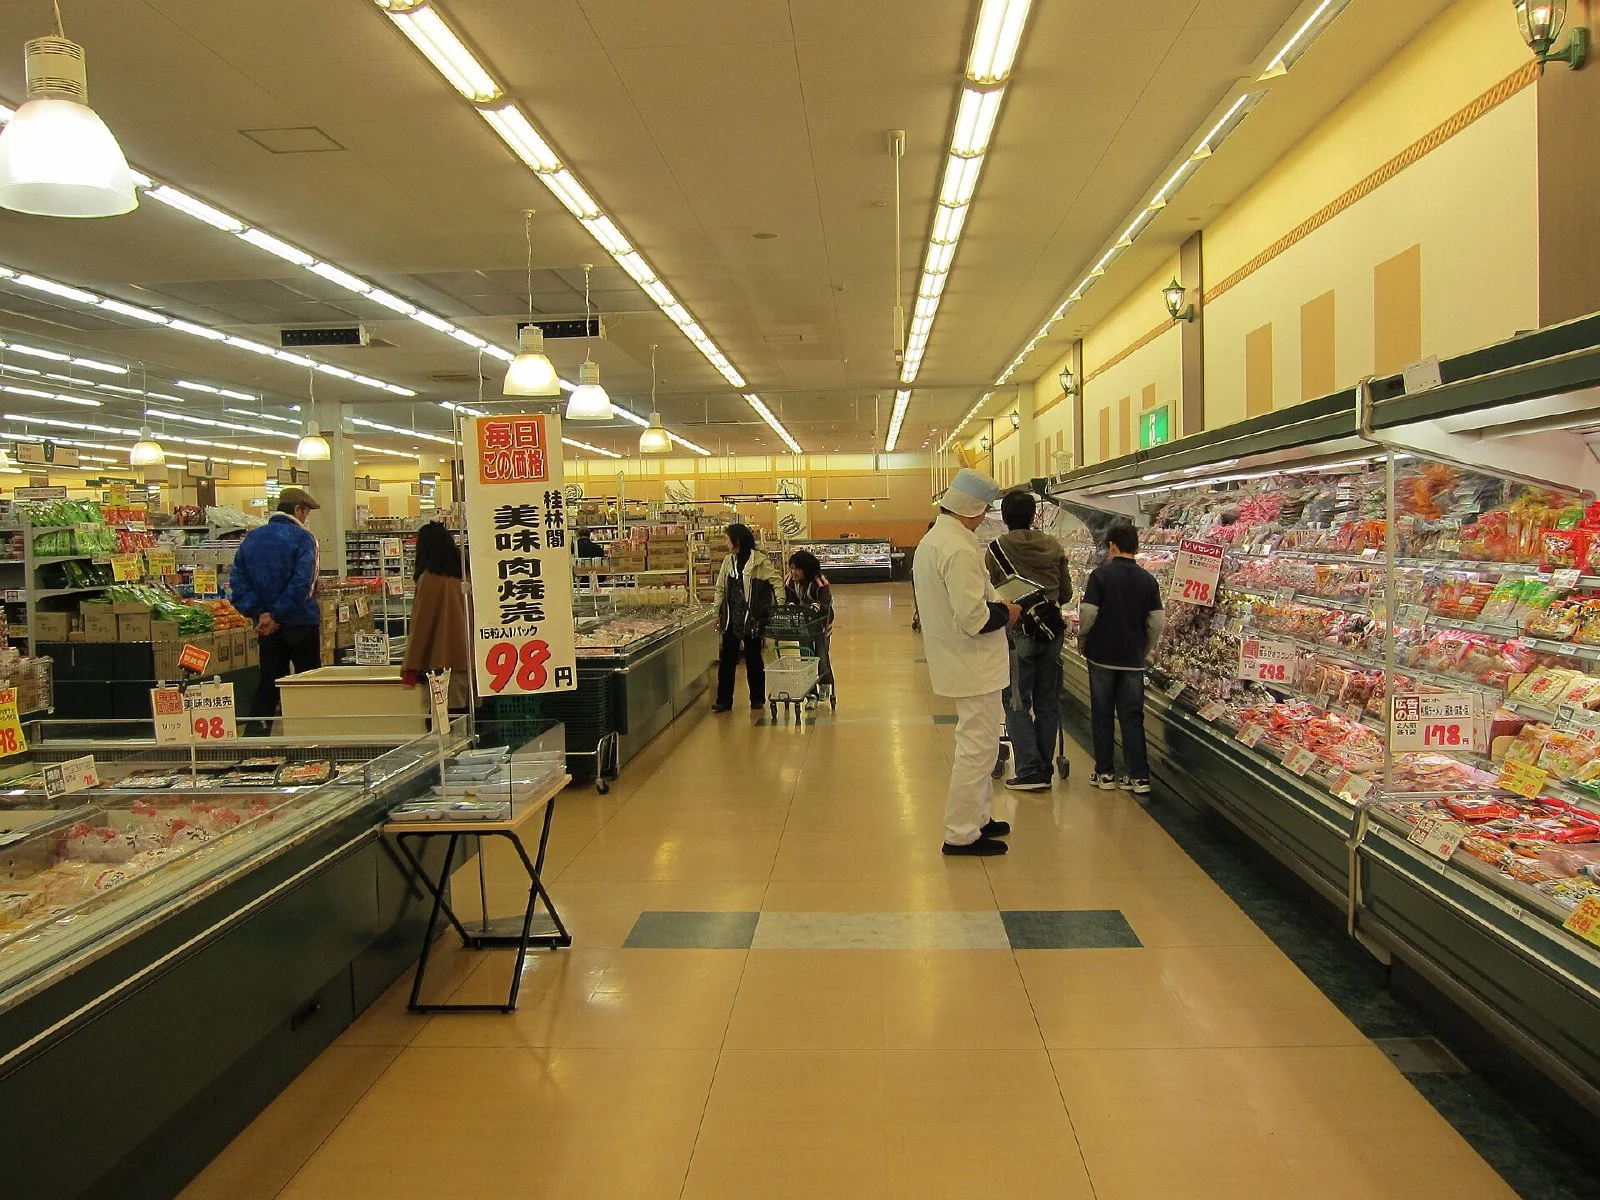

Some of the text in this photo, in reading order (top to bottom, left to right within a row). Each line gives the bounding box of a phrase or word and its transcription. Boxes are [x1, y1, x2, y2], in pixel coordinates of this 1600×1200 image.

[485, 422, 539, 448] 毎日
[483, 449, 545, 479] この価格
[493, 504, 546, 624] 美味肉焼売
[1183, 579, 1210, 601] 278
[479, 624, 538, 640] 15粒入1パック
[485, 639, 551, 693] 98
[554, 666, 573, 689] 円
[1258, 663, 1285, 680] 298
[1395, 698, 1419, 709] 広告
[1395, 709, 1419, 721] の品
[194, 716, 225, 739] 98
[1423, 724, 1461, 746] 178
